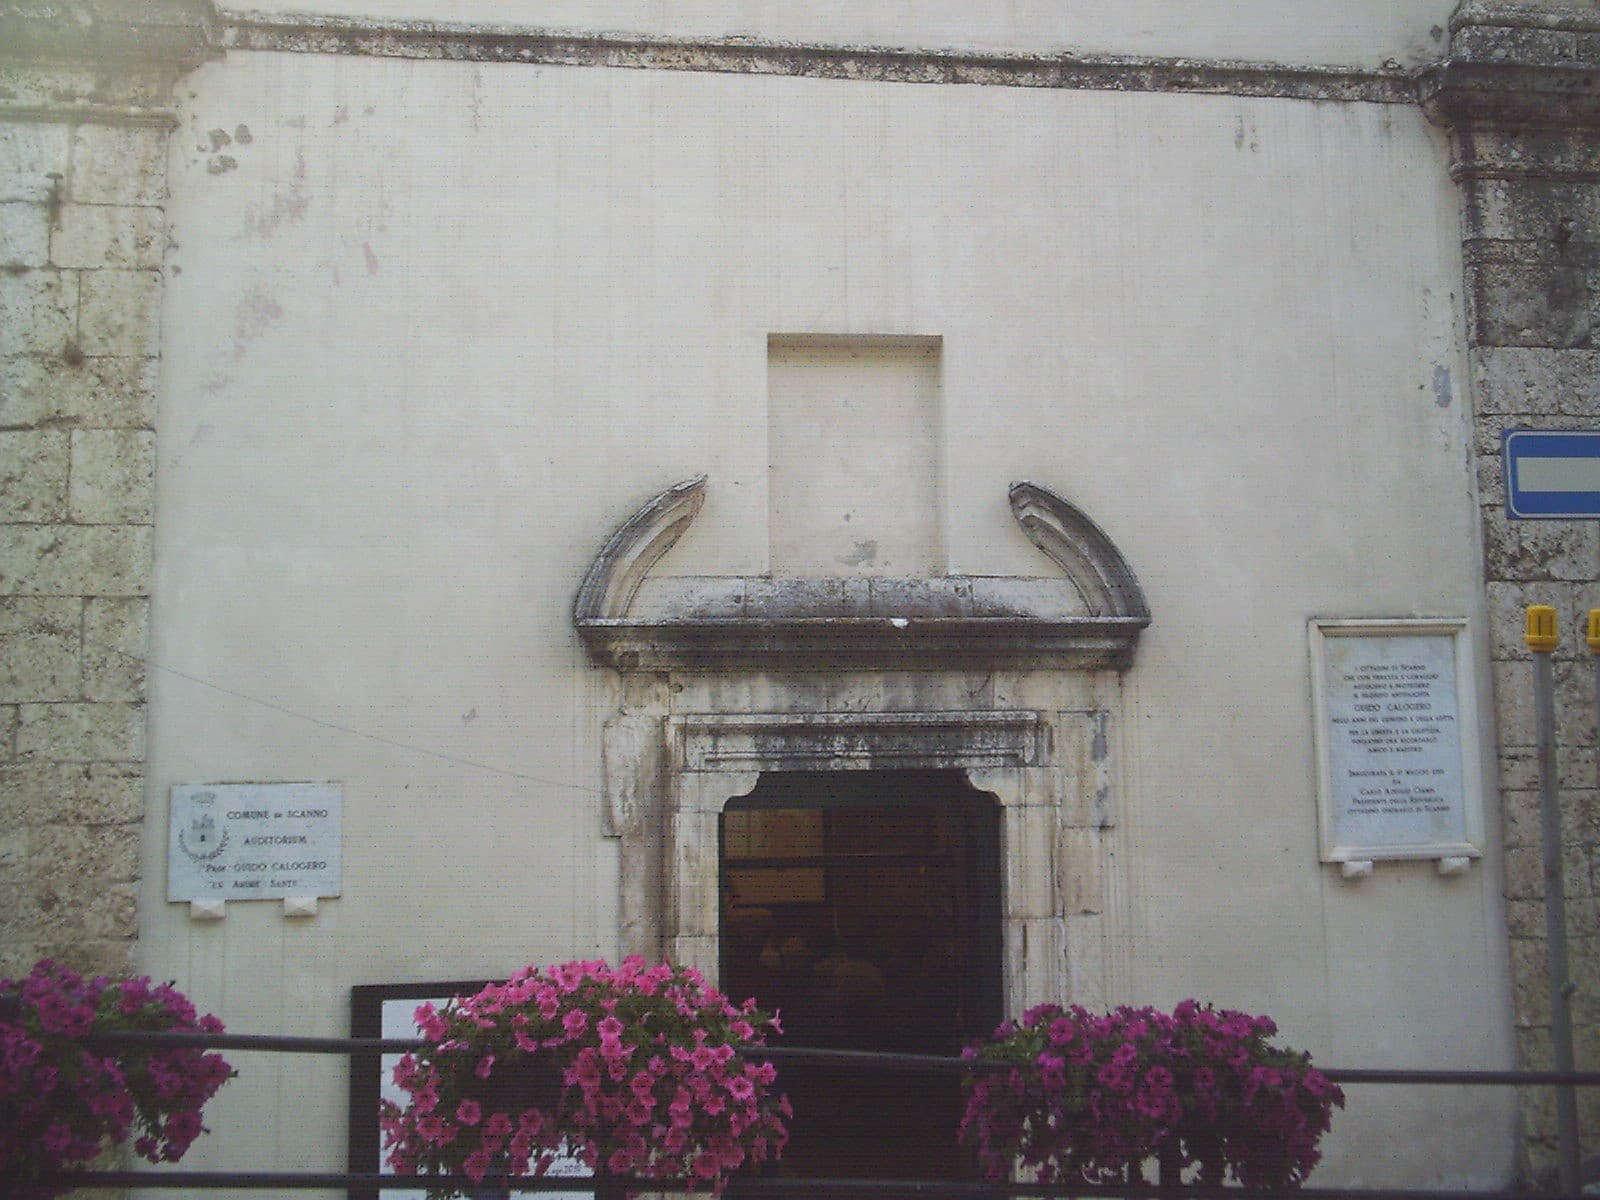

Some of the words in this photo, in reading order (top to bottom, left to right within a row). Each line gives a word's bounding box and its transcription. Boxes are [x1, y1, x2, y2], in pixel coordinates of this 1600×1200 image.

[1354, 704, 1381, 712] GUIDO
[1387, 703, 1432, 711] CALOGERO
[226, 810, 270, 820] COMUNE
[288, 810, 328, 818] SCANNO
[244, 836, 308, 845] AUDITORIUM
[234, 863, 268, 872] GUIDO
[271, 861, 327, 870] CALOGERO
